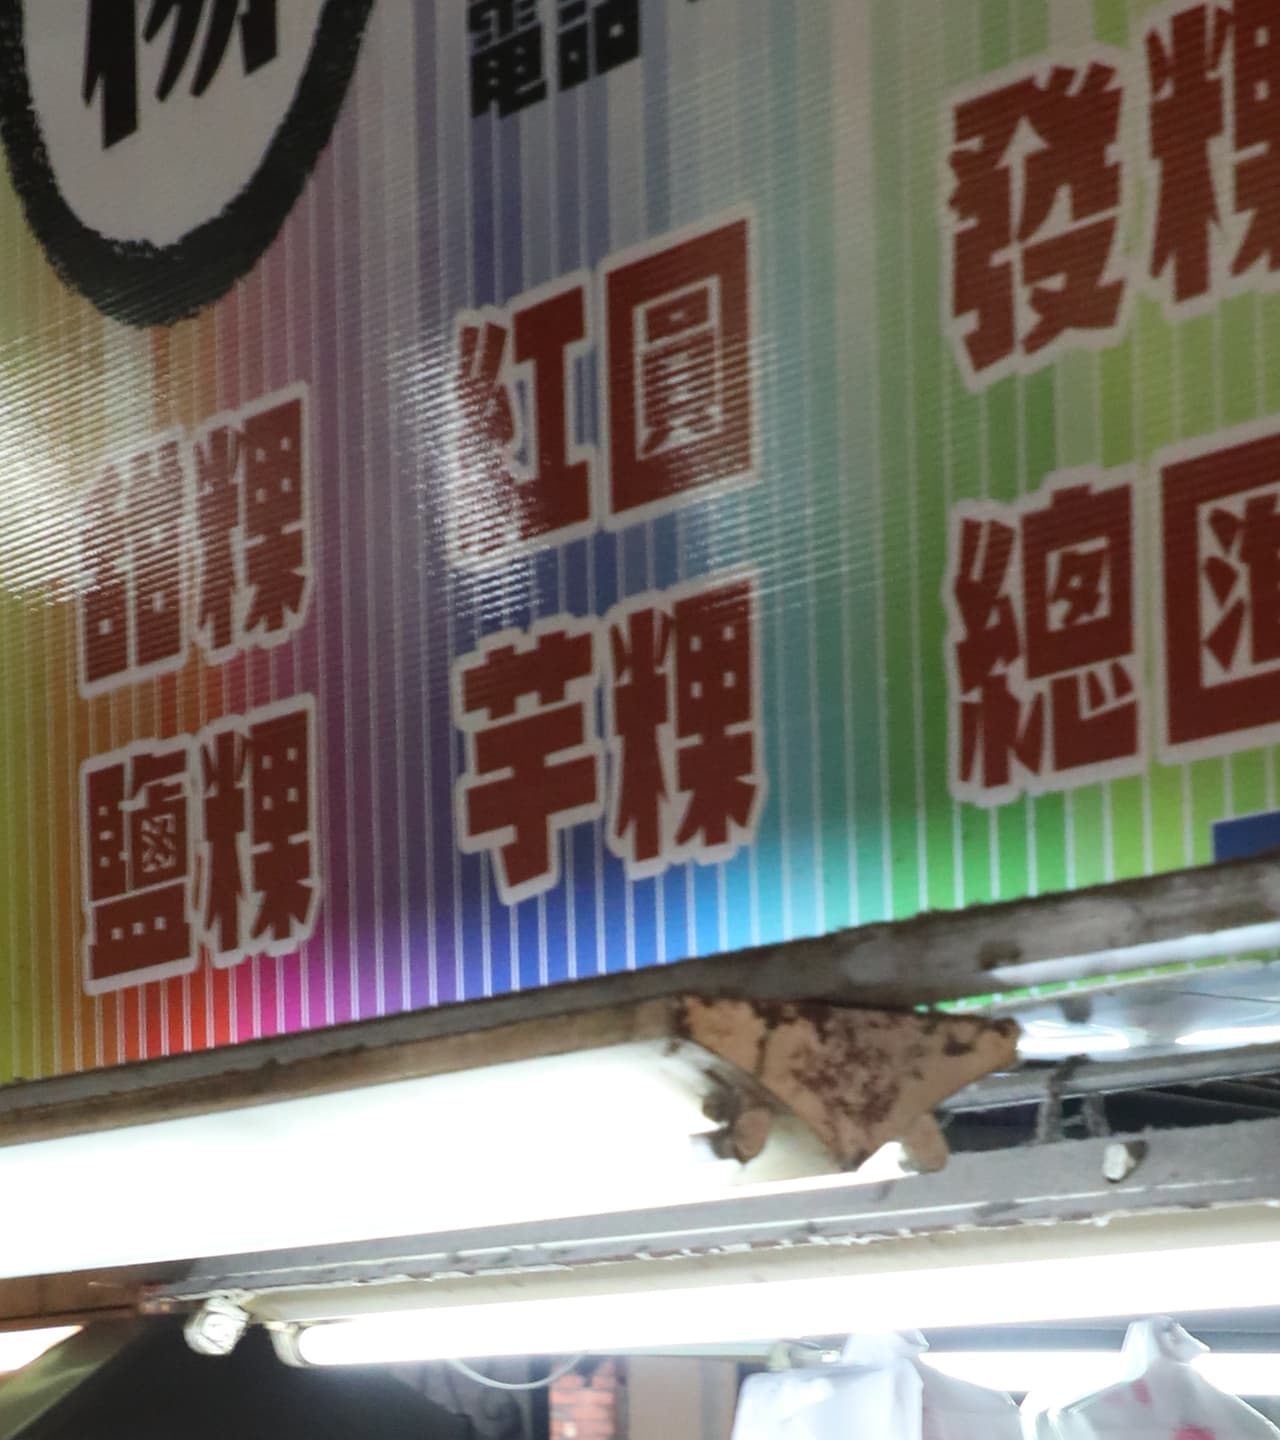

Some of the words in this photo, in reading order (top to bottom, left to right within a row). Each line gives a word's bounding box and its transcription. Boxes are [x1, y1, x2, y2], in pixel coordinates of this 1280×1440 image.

[456, 216, 755, 558] 紅圓
[85, 708, 314, 982] 鹽粿
[461, 578, 760, 890] 芋粿
